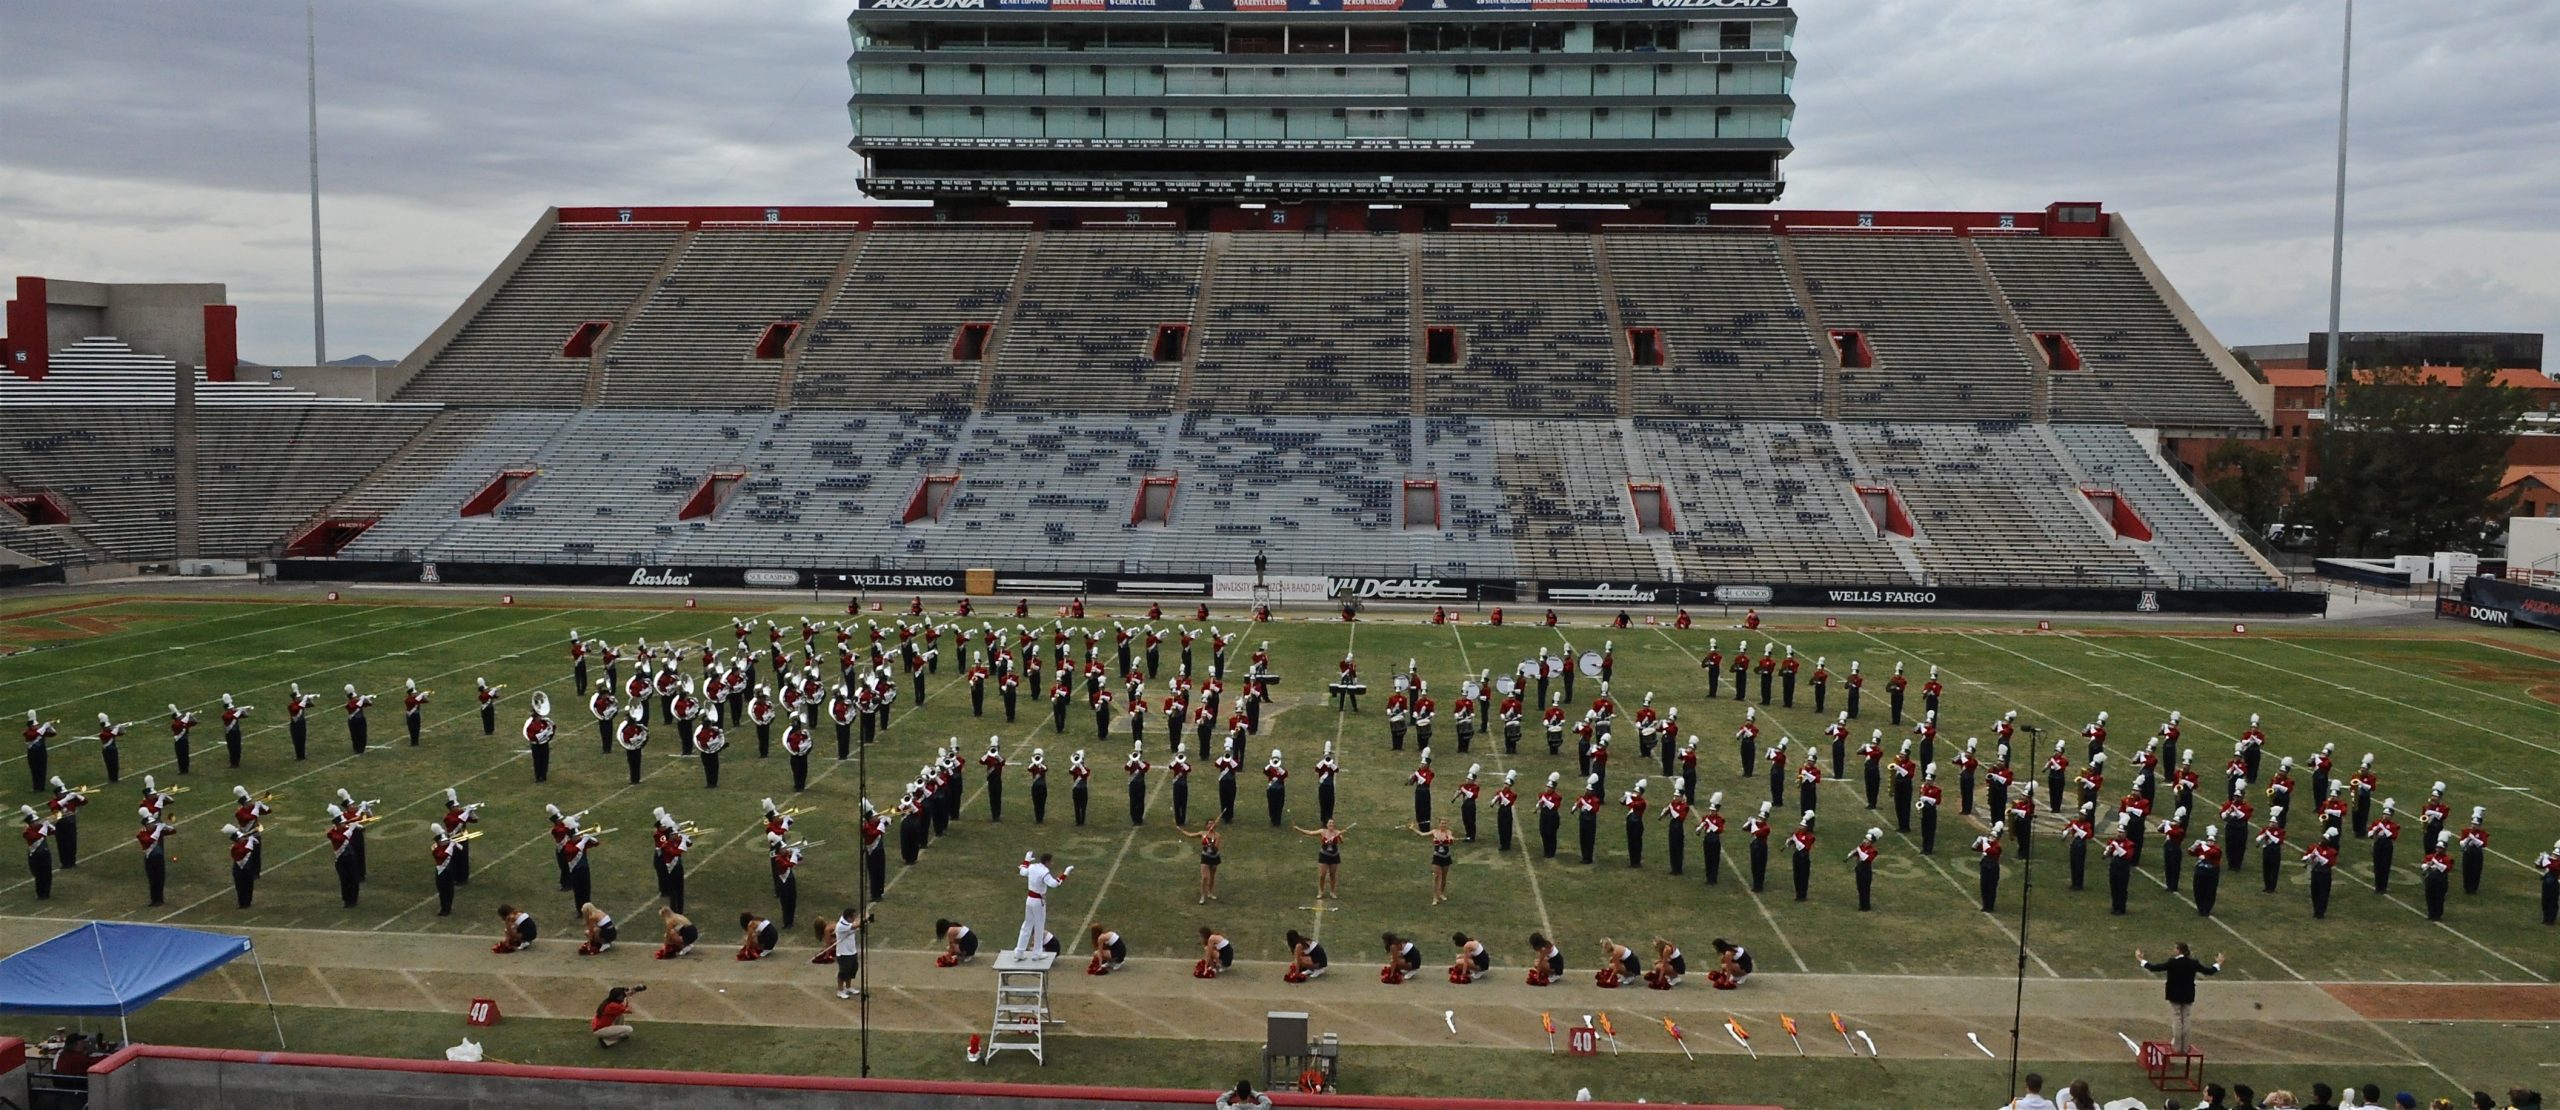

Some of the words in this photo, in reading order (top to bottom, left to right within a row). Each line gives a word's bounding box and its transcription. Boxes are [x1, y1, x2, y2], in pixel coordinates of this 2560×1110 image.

[620, 213, 631, 222] 17
[767, 213, 778, 222] 18
[1127, 214, 1140, 222] 20
[1273, 214, 1285, 223] 21
[1496, 216, 1508, 224] 22
[1695, 216, 1708, 225] 23
[1859, 218, 1872, 227] 24
[2000, 219, 2014, 228] 25
[16, 353, 27, 361] 15
[272, 370, 282, 379] 16
[628, 568, 693, 587] Bashas'
[852, 575, 902, 586] WELLS
[905, 576, 954, 587] FARGO
[1215, 582, 1251, 592] UNIVERSITY
[1292, 583, 1310, 593] BAND
[1311, 583, 1325, 593] DAY
[1829, 591, 1882, 602] WELLS
[1885, 592, 1936, 603] FARGO
[2441, 600, 2469, 616] BEAR
[2470, 606, 2508, 624] DOWN
[470, 1002, 489, 1022] 40
[1573, 1031, 1592, 1052] 40
